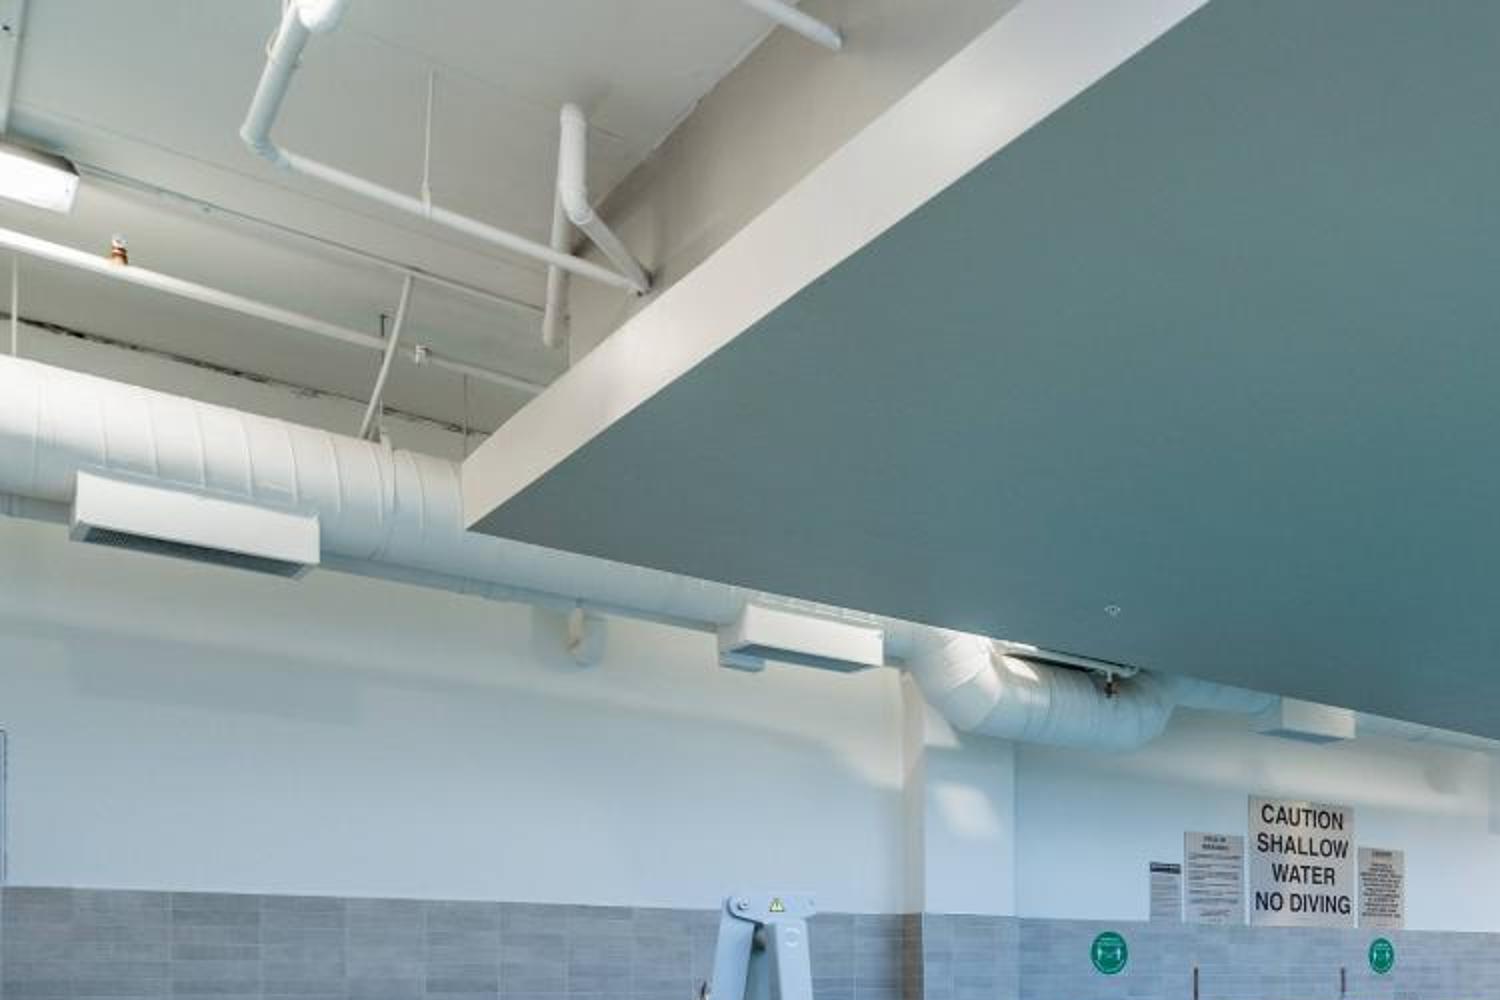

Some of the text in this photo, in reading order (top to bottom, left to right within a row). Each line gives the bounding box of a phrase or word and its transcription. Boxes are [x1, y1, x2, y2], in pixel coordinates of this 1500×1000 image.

[1261, 804, 1343, 830] CAUTION
[1257, 832, 1348, 858] SHALLOW
[1272, 863, 1335, 885] WATER
[1255, 891, 1351, 914] NO DIVING
